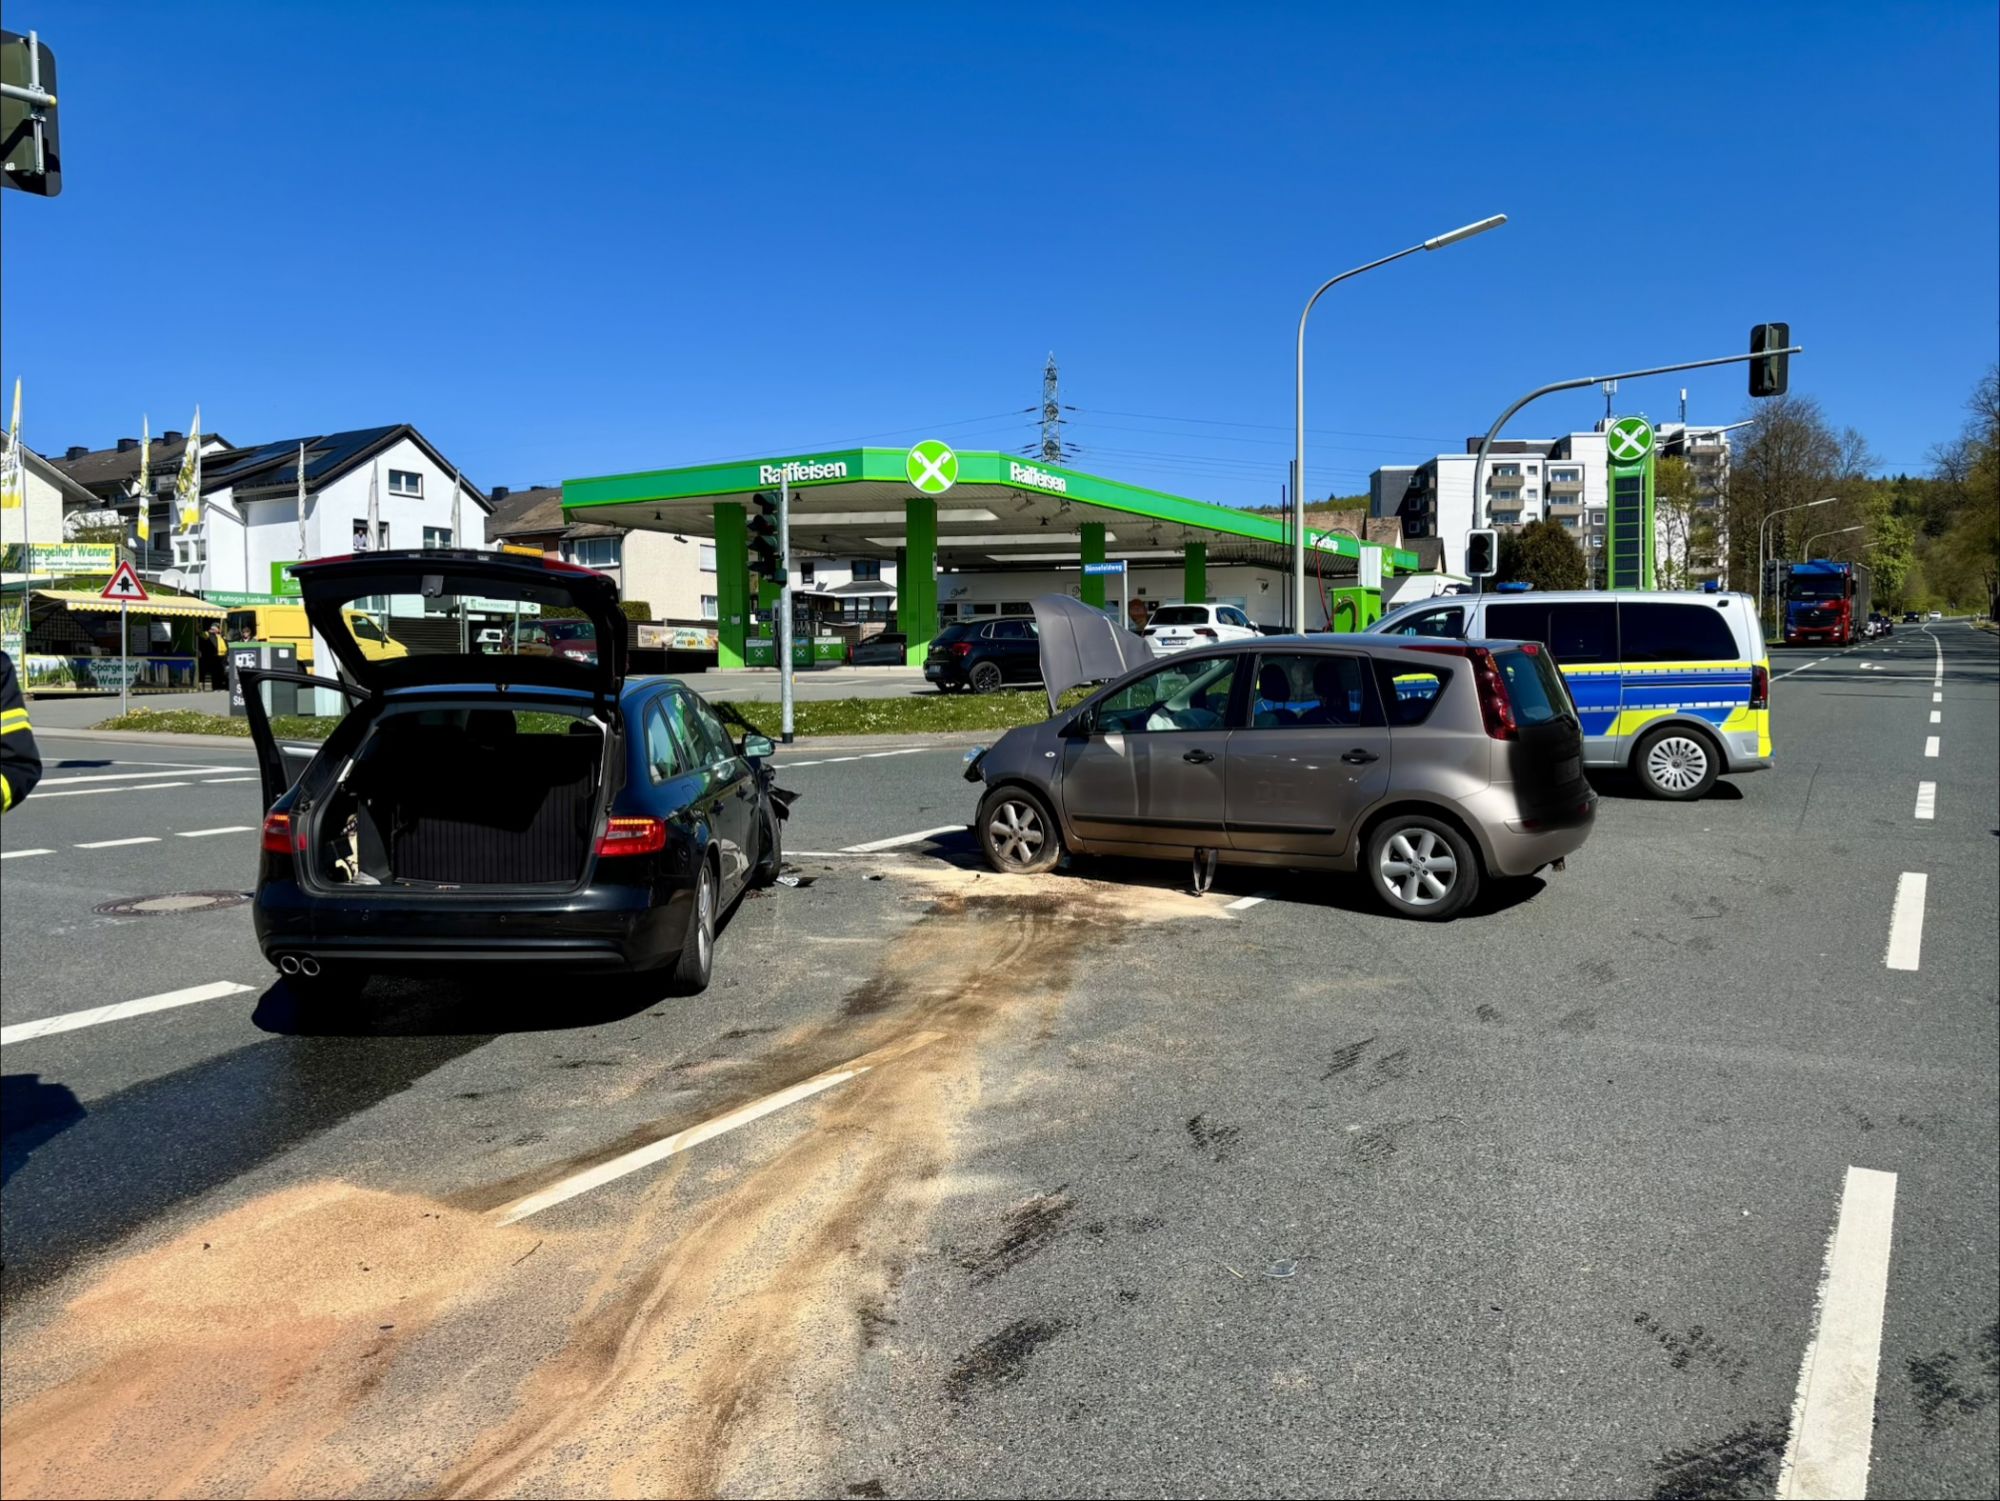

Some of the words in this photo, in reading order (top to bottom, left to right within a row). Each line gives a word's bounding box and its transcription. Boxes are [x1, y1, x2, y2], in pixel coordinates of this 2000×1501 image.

[760, 460, 847, 485] Raffeisen
[1010, 461, 1067, 492] Raiffeisen
[29, 545, 73, 560] pargelhof
[77, 545, 113, 557] Wenner
[219, 594, 246, 604] Autogas
[247, 596, 270, 604] tanken
[90, 661, 140, 675] Spargehof
